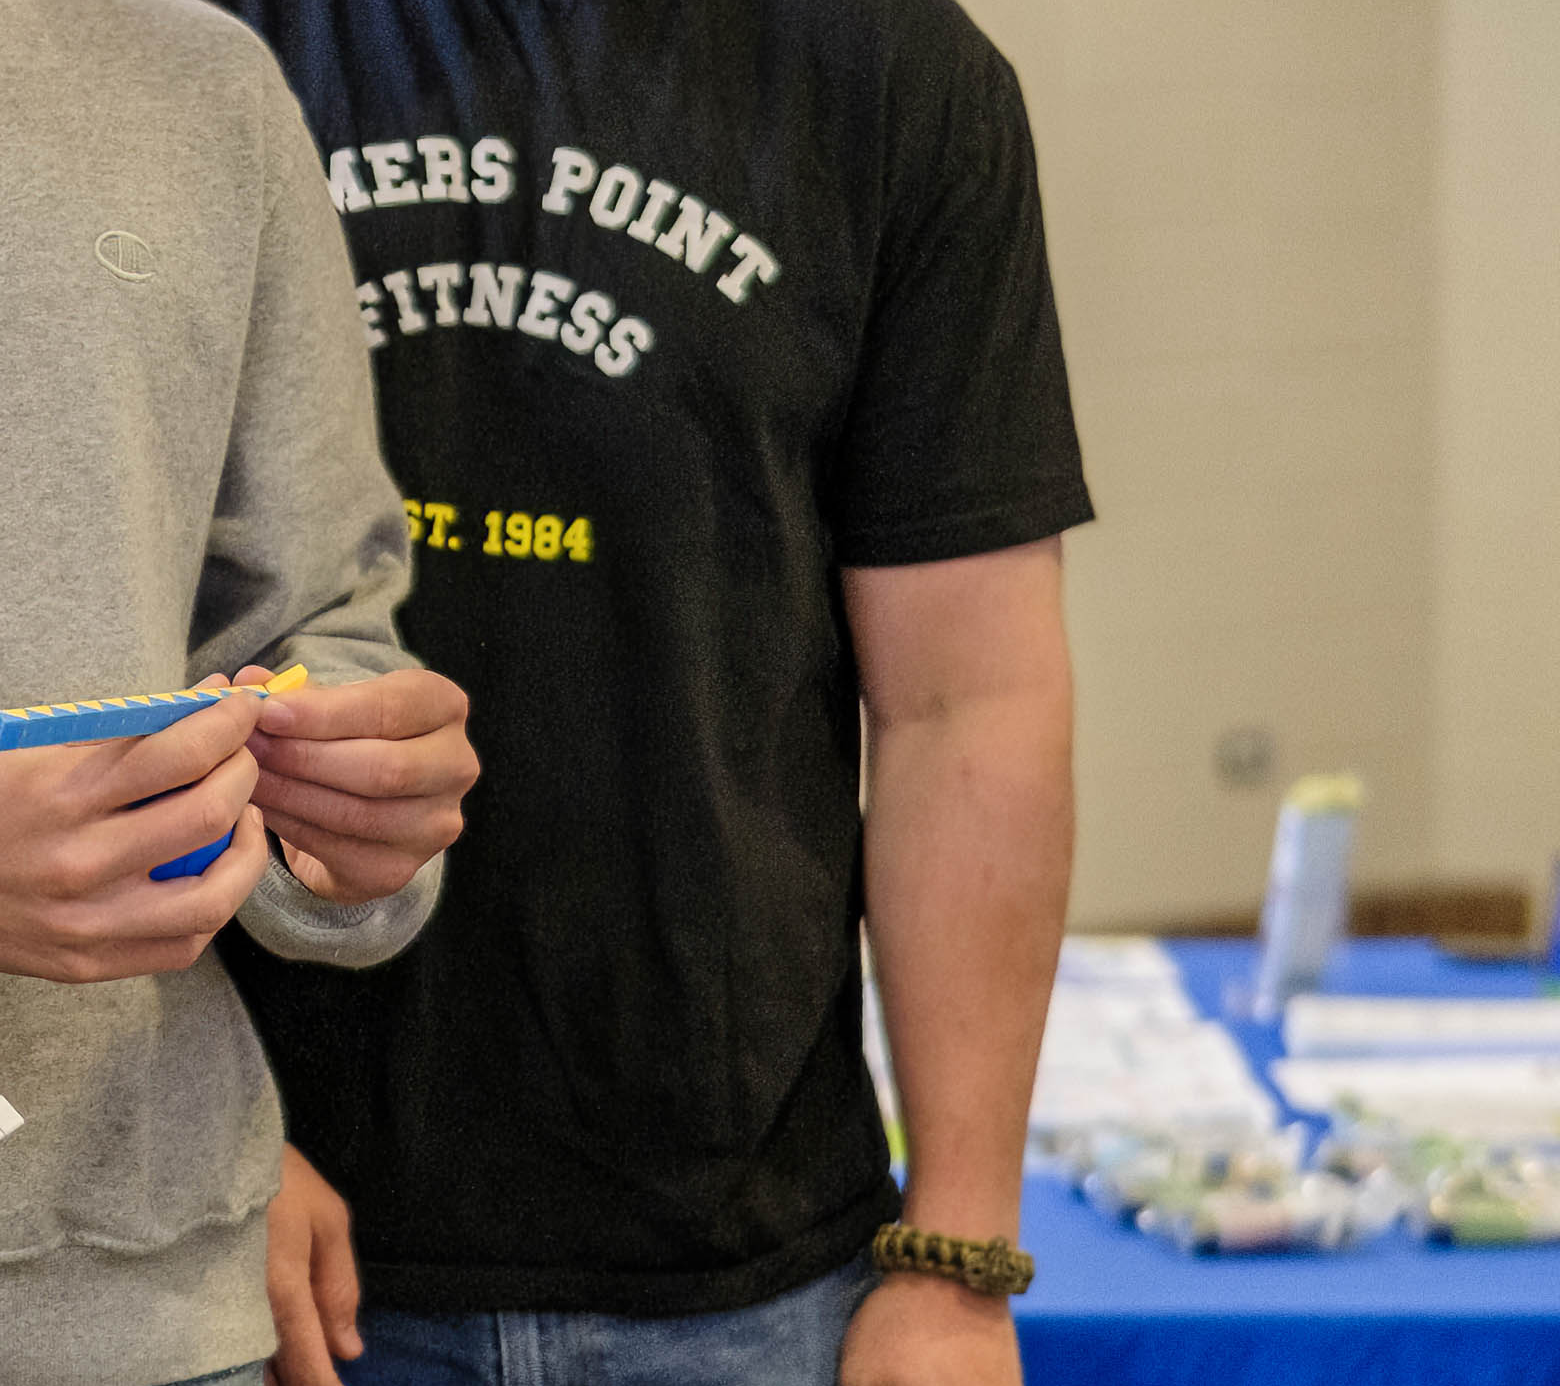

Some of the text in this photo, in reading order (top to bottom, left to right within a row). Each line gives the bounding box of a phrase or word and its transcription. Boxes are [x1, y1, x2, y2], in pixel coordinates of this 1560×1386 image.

[329, 134, 782, 306] MERS POINT
[402, 499, 593, 562] ST. 1984
